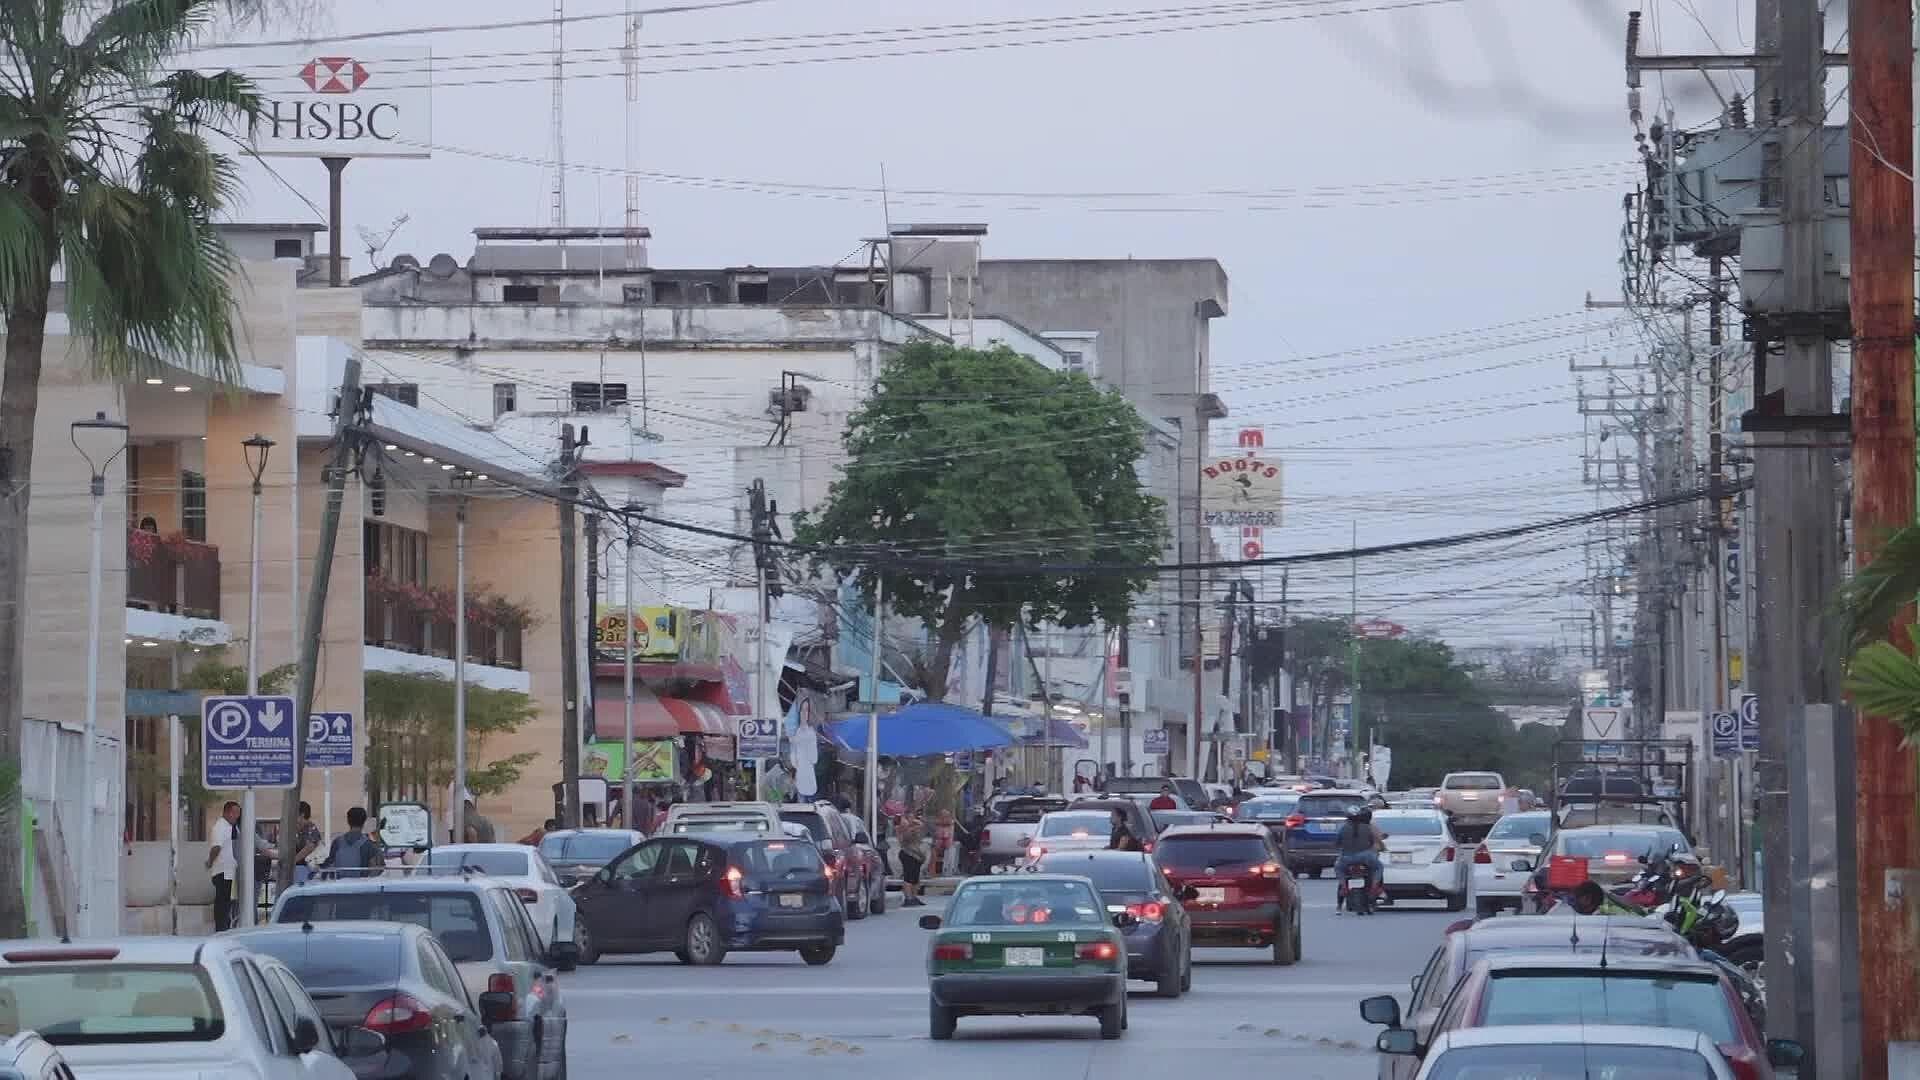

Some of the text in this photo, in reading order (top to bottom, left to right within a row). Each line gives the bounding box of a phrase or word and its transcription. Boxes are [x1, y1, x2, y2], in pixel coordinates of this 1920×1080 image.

[271, 101, 399, 140] HSBC
[1203, 459, 1279, 479] BOOTS
[246, 736, 291, 748] TERMINA
